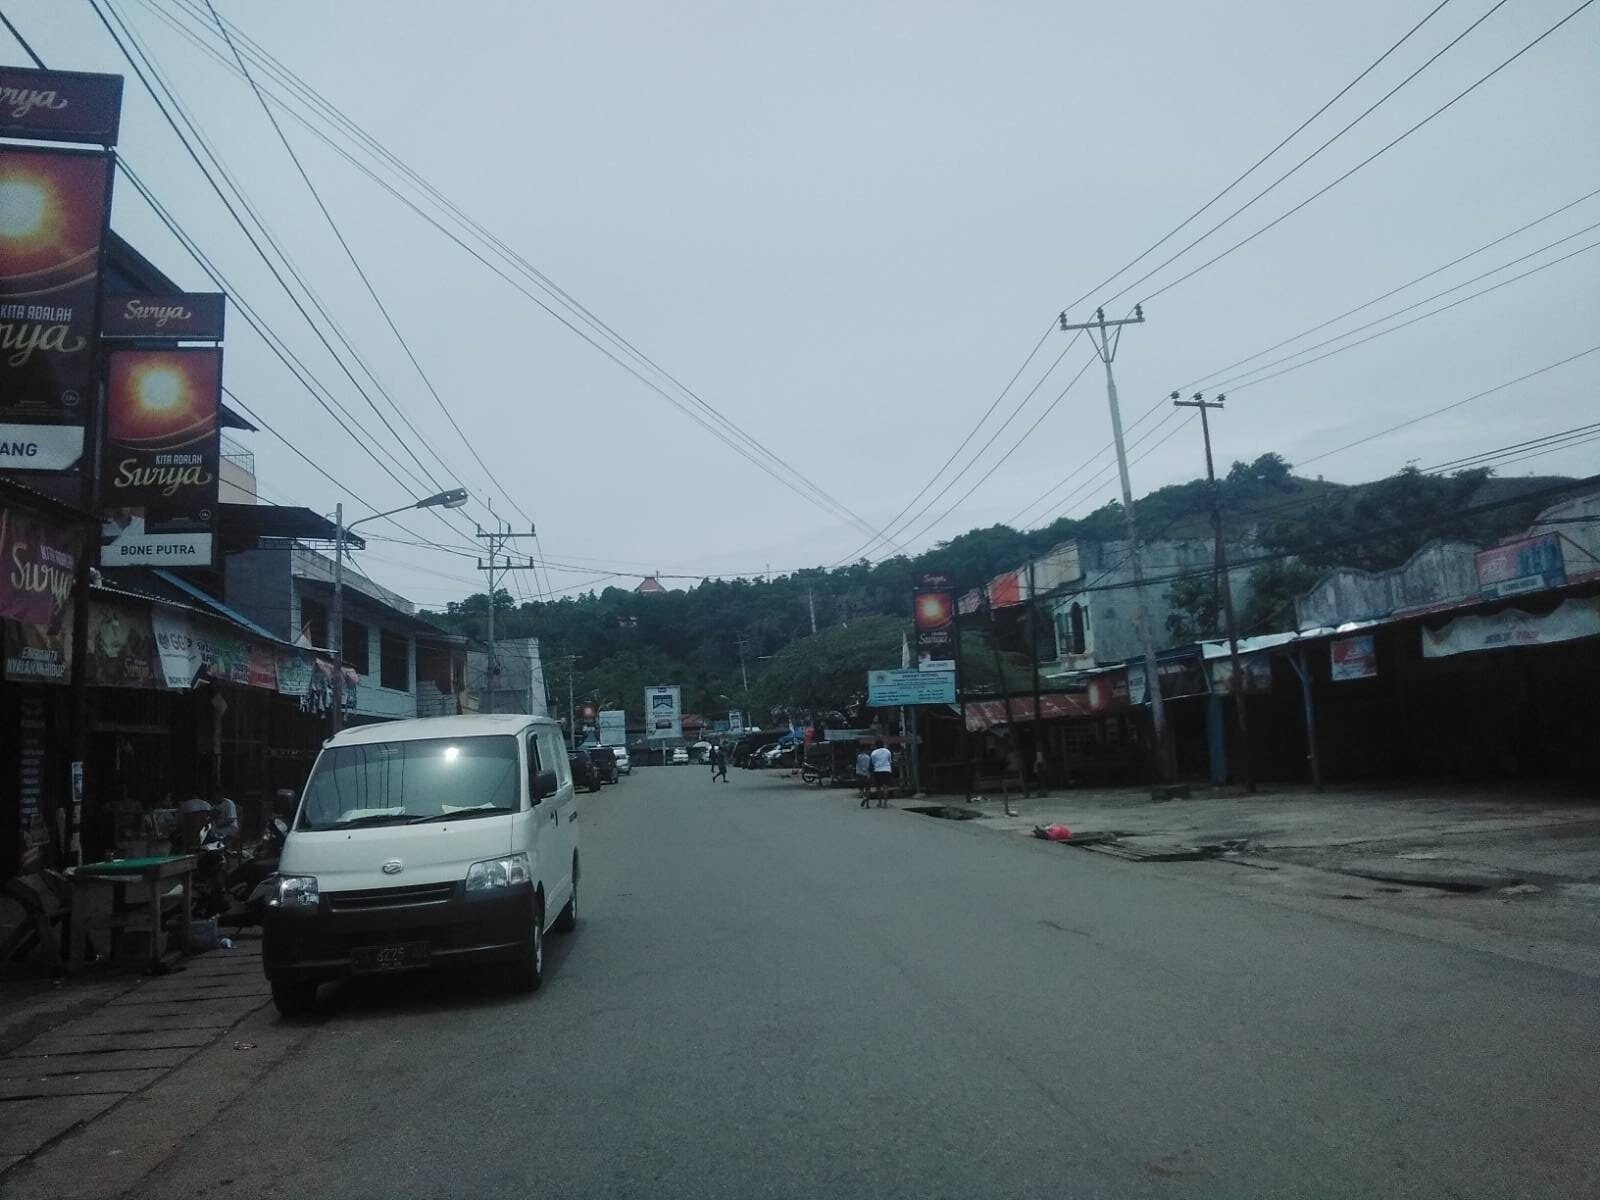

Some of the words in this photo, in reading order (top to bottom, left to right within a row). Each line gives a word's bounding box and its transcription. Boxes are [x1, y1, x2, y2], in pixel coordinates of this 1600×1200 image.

[0, 87, 68, 118] rya
[0, 304, 25, 319] KITA
[27, 305, 73, 322] ADALAH
[124, 299, 192, 327] Surya
[155, 455, 172, 465] KITA
[173, 454, 202, 465] ADALAH
[114, 458, 214, 496] Surya
[121, 545, 153, 556] BONE
[156, 545, 196, 555] PUTRA
